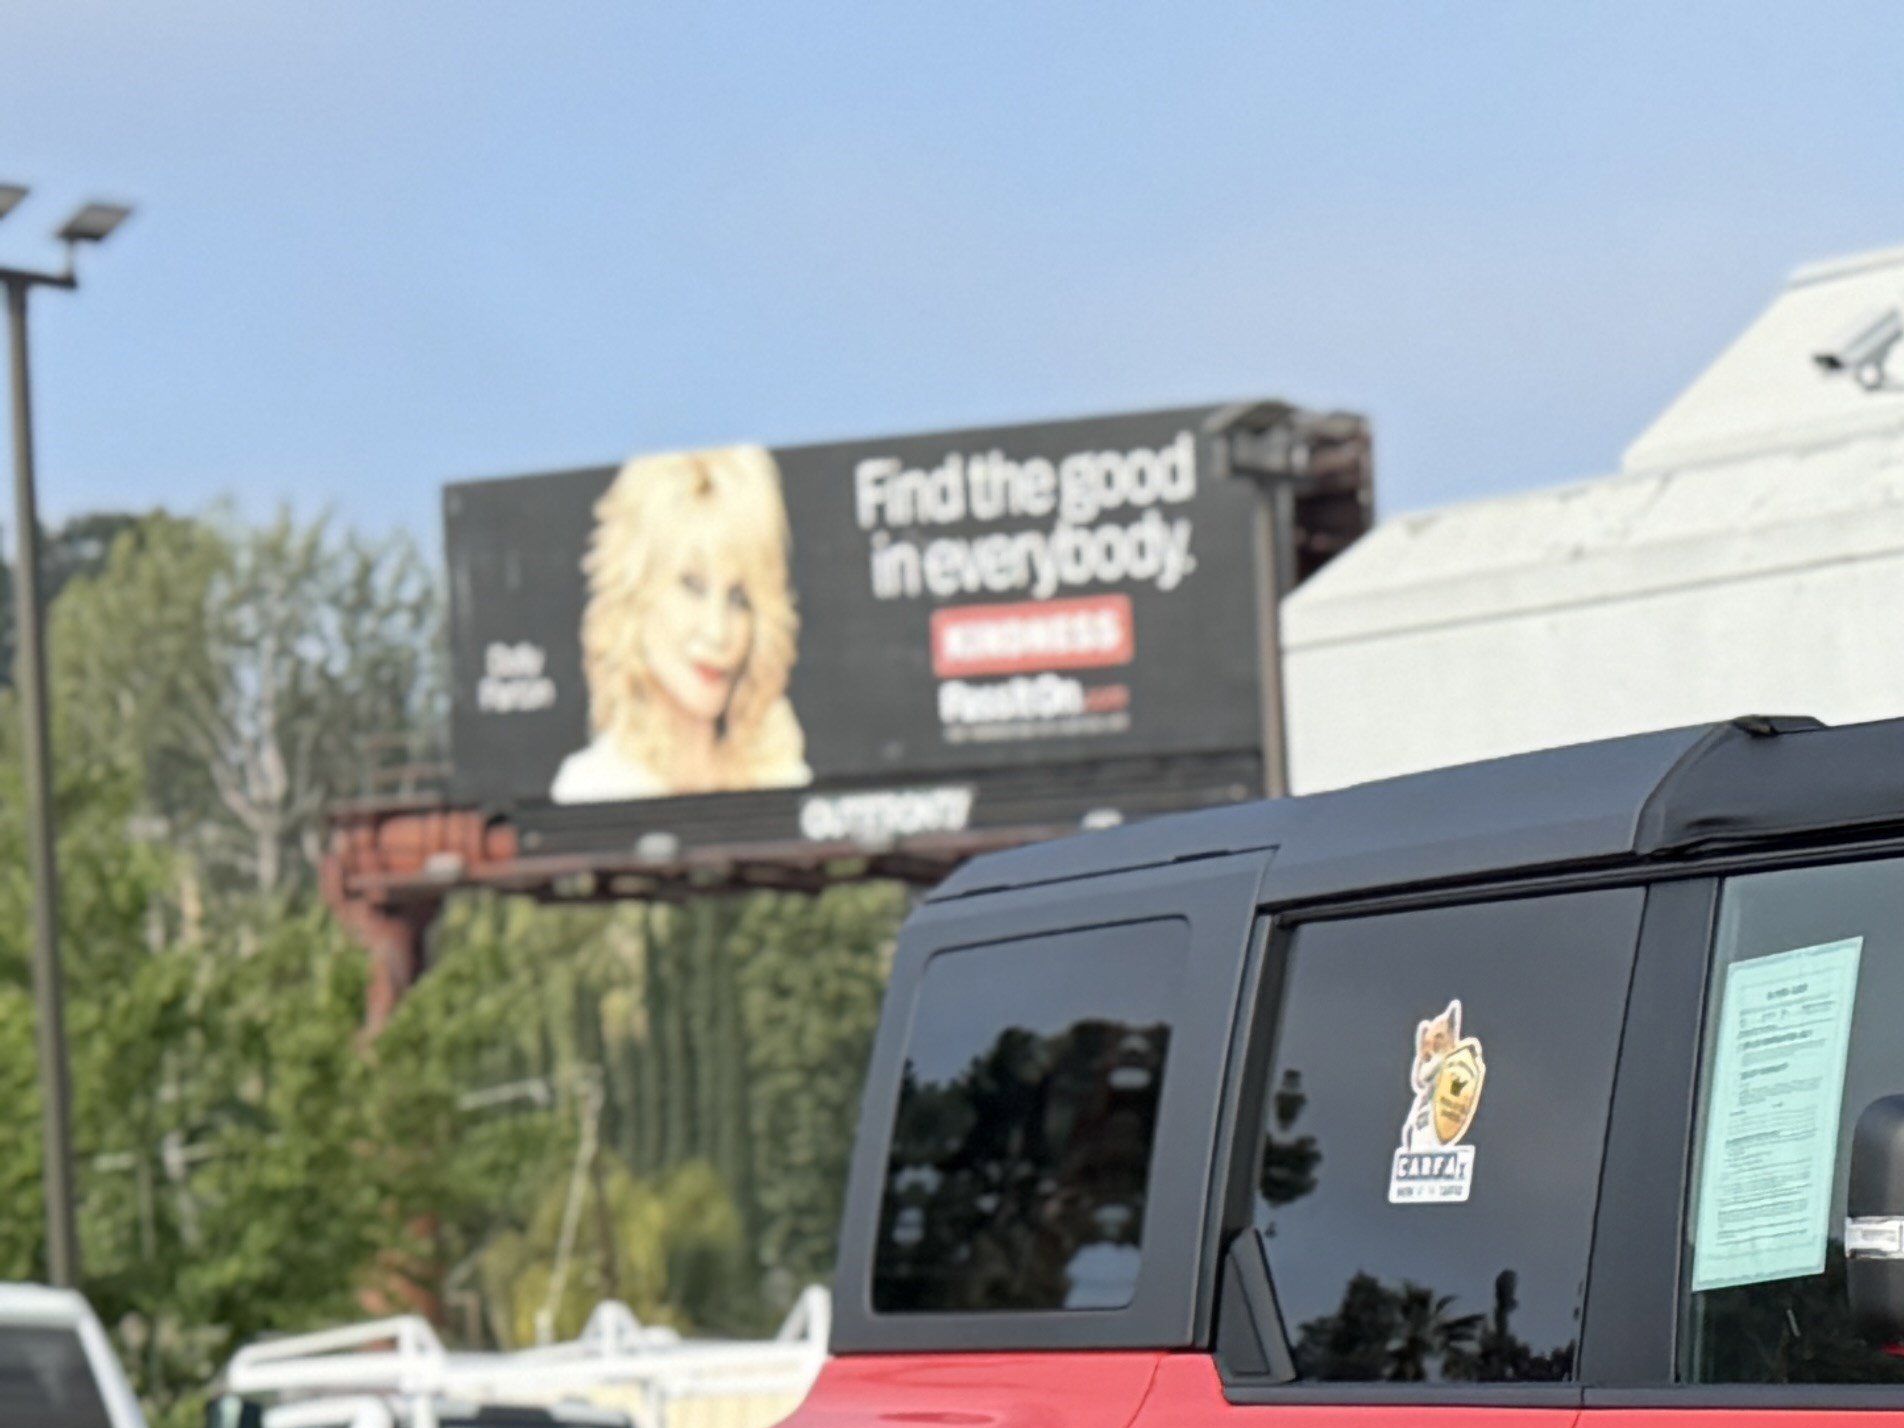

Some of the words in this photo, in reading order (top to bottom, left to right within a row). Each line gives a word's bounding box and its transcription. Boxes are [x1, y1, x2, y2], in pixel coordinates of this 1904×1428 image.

[856, 455, 966, 530] Find
[968, 449, 1057, 521] the
[1058, 430, 1196, 524] good
[870, 529, 922, 600] in
[922, 508, 1197, 601] everybody.
